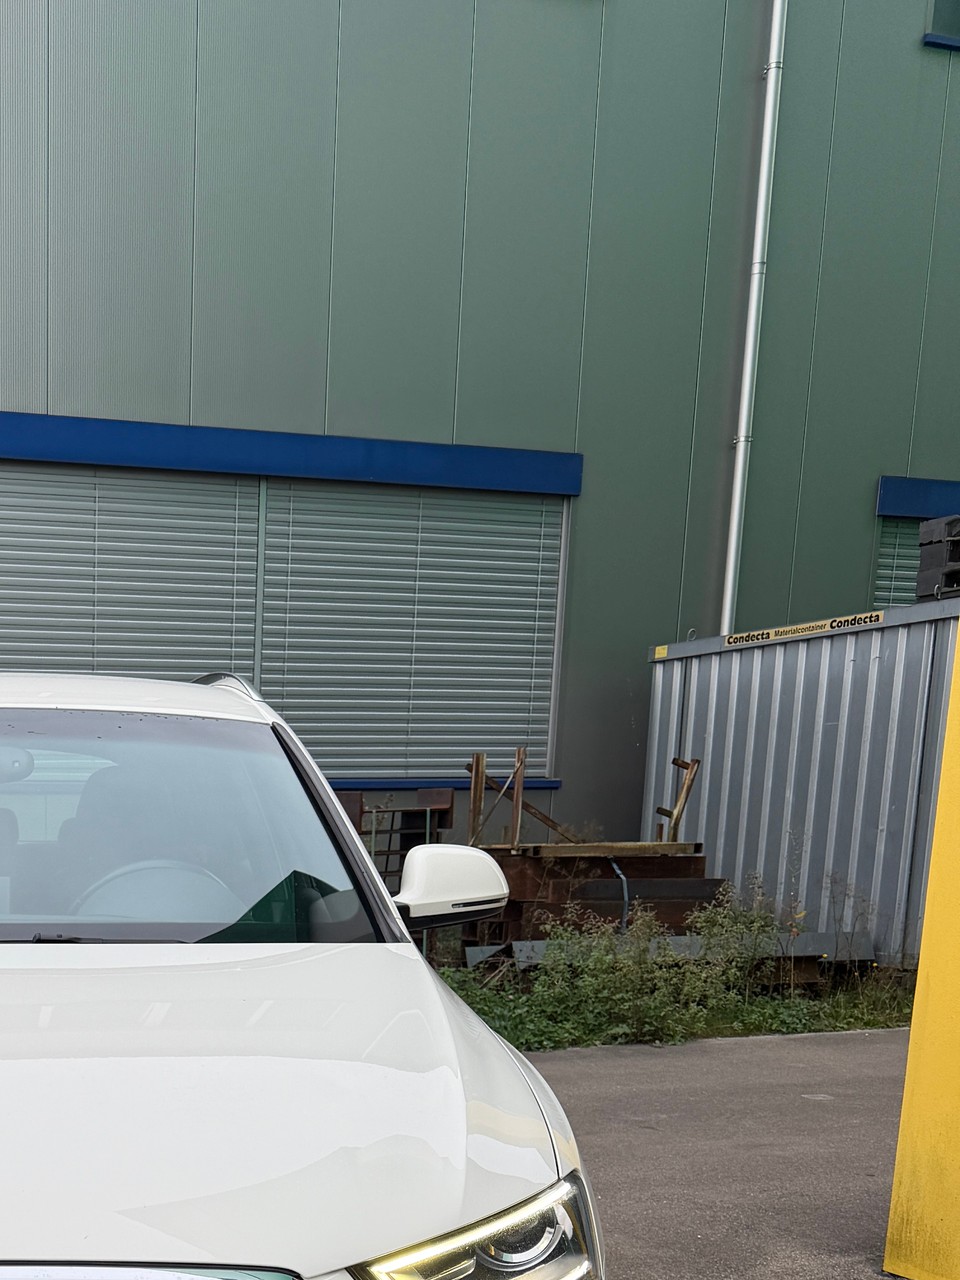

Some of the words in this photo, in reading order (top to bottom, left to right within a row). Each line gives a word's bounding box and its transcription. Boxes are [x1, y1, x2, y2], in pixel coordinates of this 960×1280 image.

[727, 631, 771, 645] Condecta
[774, 624, 827, 637] Materialcontainer
[830, 614, 880, 629] Condecta
